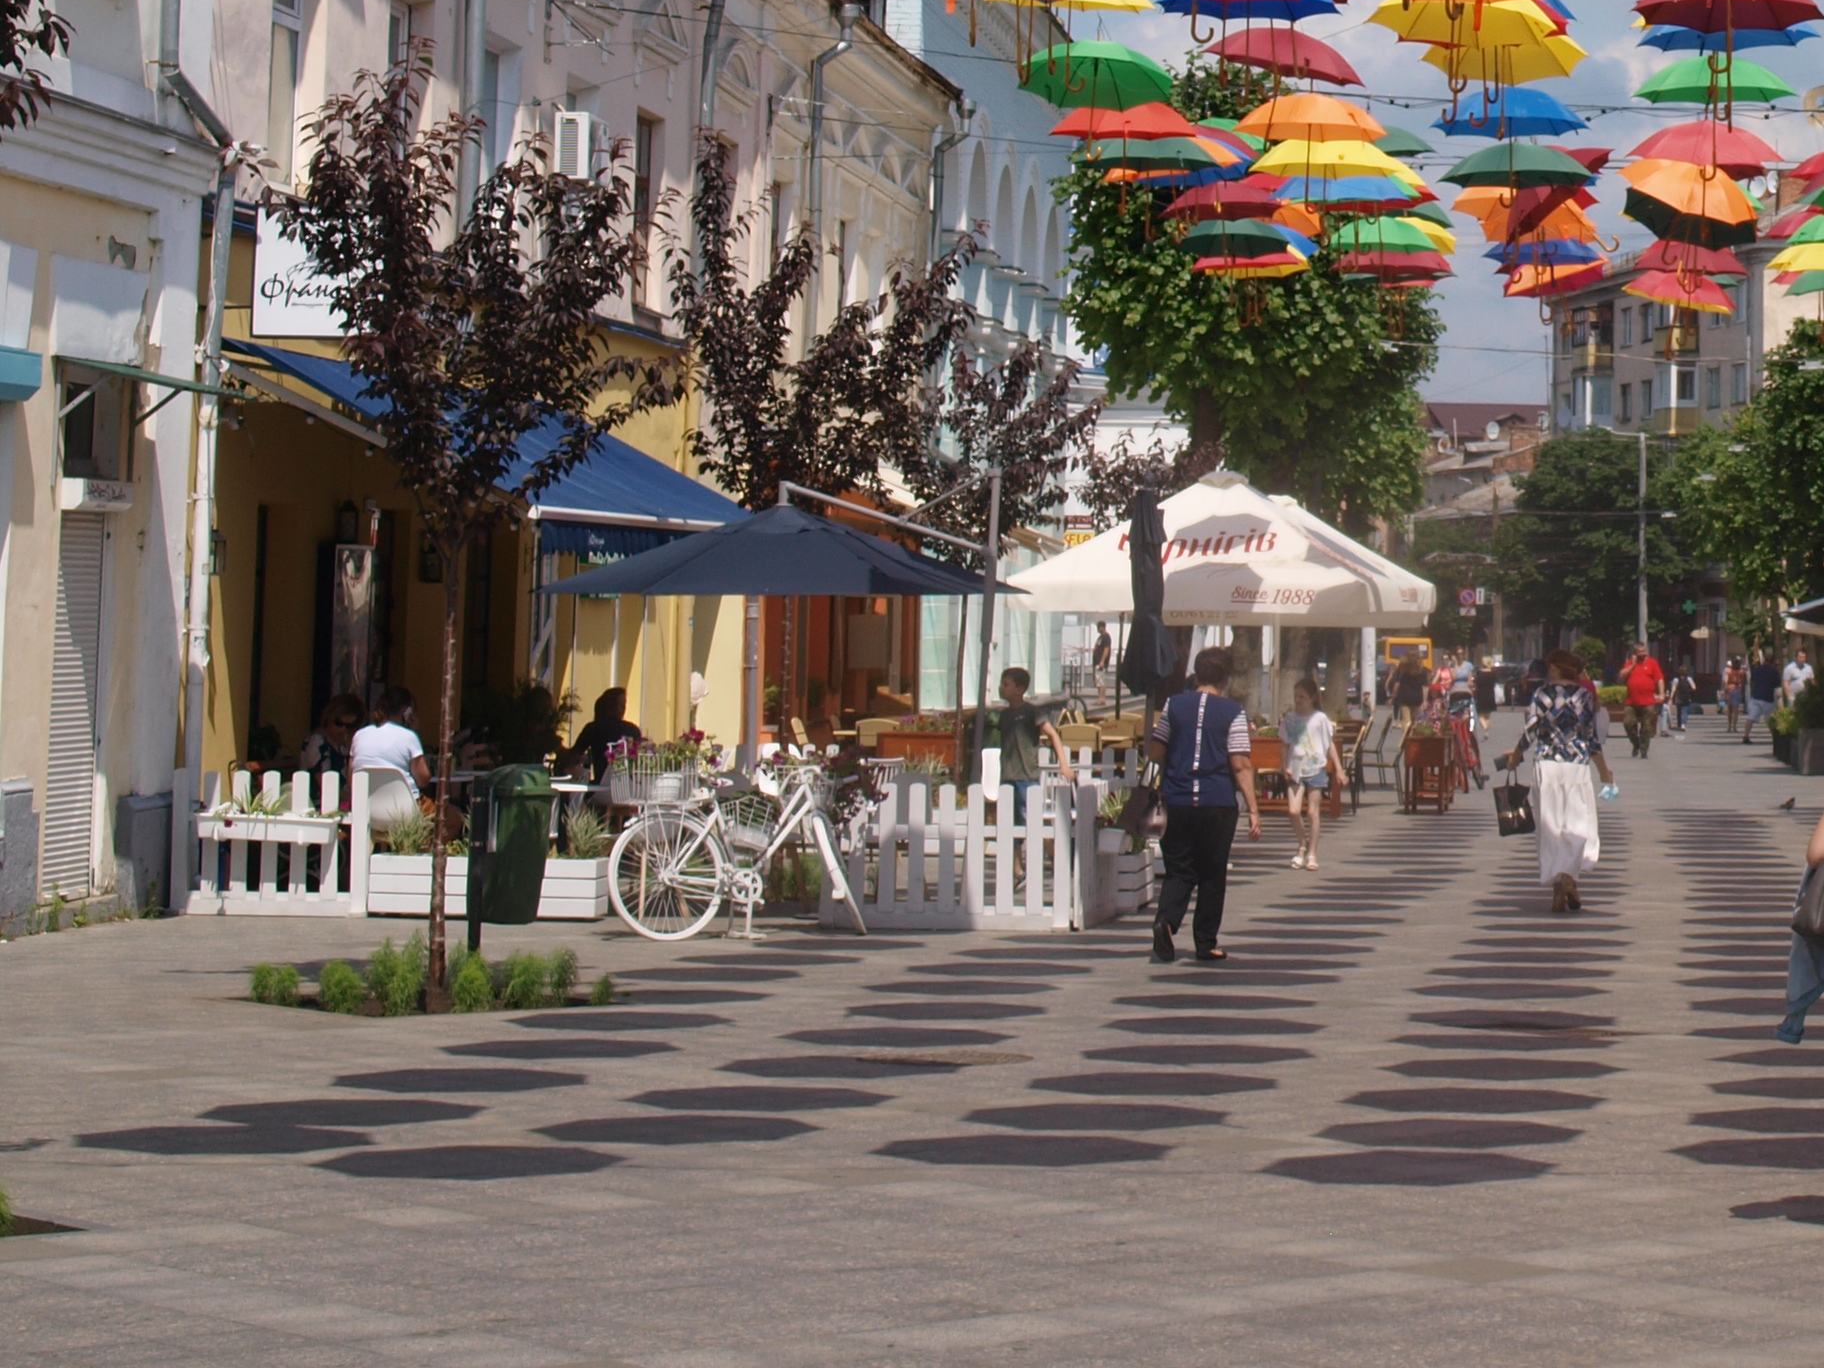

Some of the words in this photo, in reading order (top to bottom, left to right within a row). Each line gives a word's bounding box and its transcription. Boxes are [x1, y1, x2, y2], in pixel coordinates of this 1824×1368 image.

[1117, 528, 1278, 565] рнігів
[1230, 585, 1268, 604] Since
[1270, 588, 1316, 606] 1988
